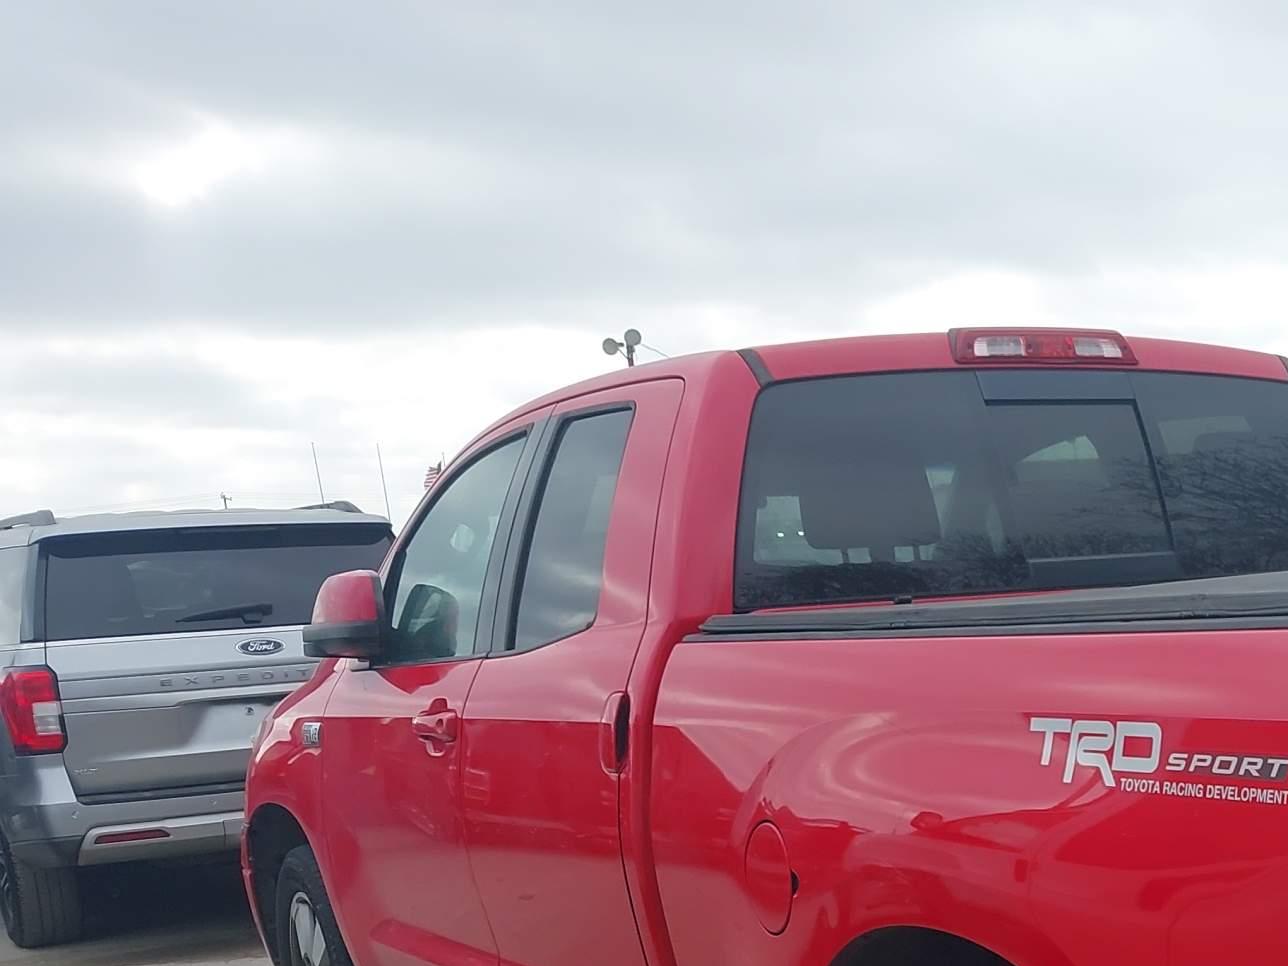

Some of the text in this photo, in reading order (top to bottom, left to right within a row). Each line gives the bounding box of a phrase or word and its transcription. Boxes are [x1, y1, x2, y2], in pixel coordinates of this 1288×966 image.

[1030, 717, 1162, 787] TRD
[1120, 778, 1160, 794] TOYOTA
[1162, 781, 1203, 798] RACING
